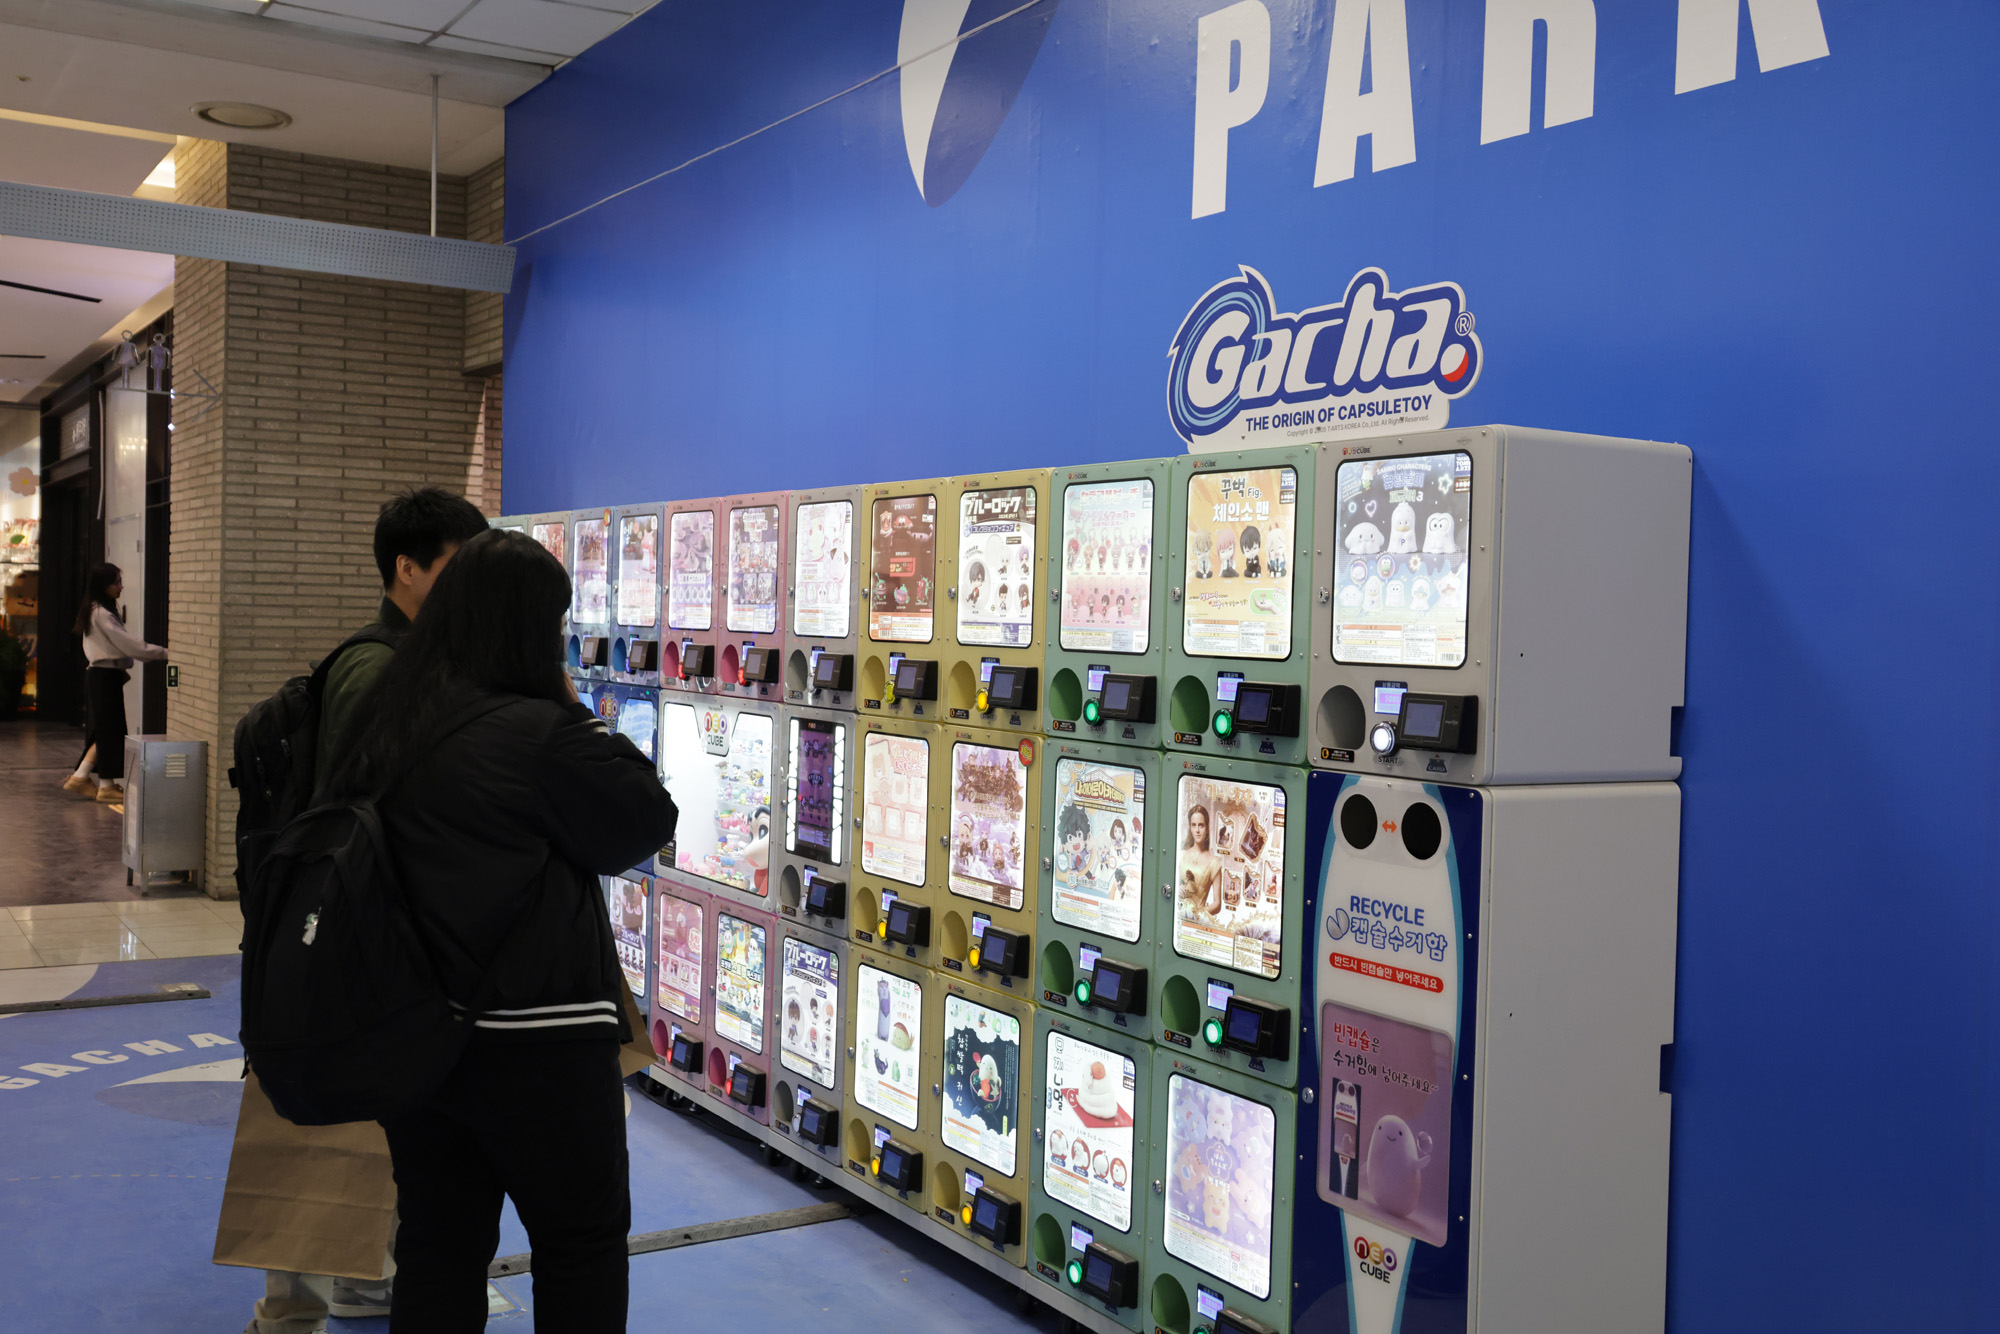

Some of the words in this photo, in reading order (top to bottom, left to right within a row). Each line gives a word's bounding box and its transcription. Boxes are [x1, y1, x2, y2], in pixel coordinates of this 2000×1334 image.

[1245, 415, 1270, 432] THE
[1271, 409, 1315, 429] ORIGIN
[1317, 405, 1335, 423] OF
[1338, 394, 1433, 420] CAPSULETOY
[1287, 428, 1309, 437] Copyright
[1344, 421, 1361, 430] KOREA
[1221, 477, 1247, 500] 꾸벅
[1247, 487, 1262, 499] Fig.
[964, 496, 1022, 515] ブルーロック
[707, 735, 724, 747] CUBE
[1378, 756, 1400, 764] START
[1350, 895, 1425, 927] RECYCLE
[1350, 916, 1448, 962] 캡슐수거함
[1334, 955, 1358, 971] 반드시
[1360, 961, 1393, 979] 빈캡슐만
[1395, 969, 1438, 990] 넣어주세요
[1333, 1021, 1381, 1053] 빈캡슐은
[1333, 1050, 1377, 1076] 수거함에
[1360, 1261, 1391, 1284] CUBE
